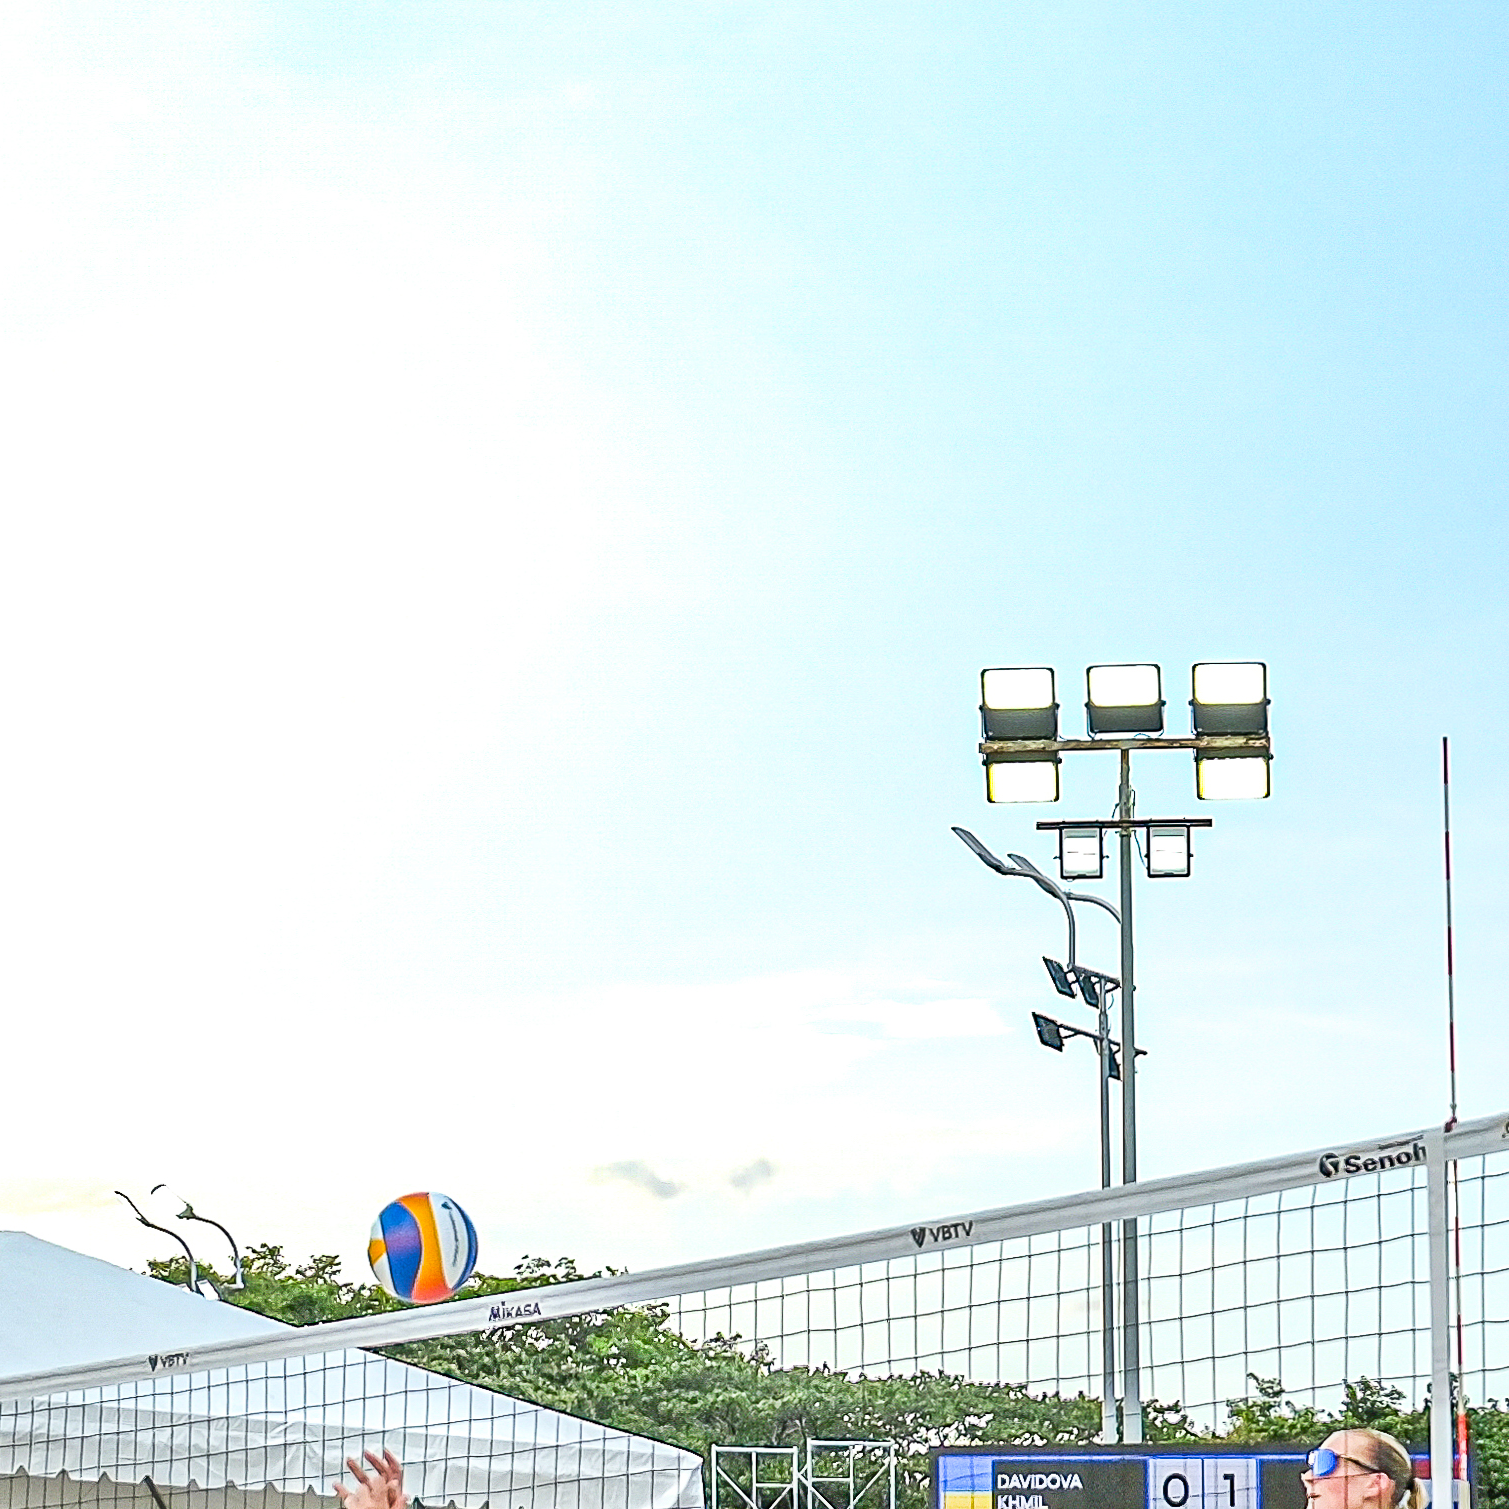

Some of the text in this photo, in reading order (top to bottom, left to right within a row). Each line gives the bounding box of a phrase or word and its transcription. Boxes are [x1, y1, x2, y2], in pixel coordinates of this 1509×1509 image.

[1344, 1142, 1427, 1175] Senoh
[929, 1219, 973, 1243] VBTV
[997, 1473, 1083, 1490] DAVIDOVA
[1162, 1472, 1236, 1508] 0 1
